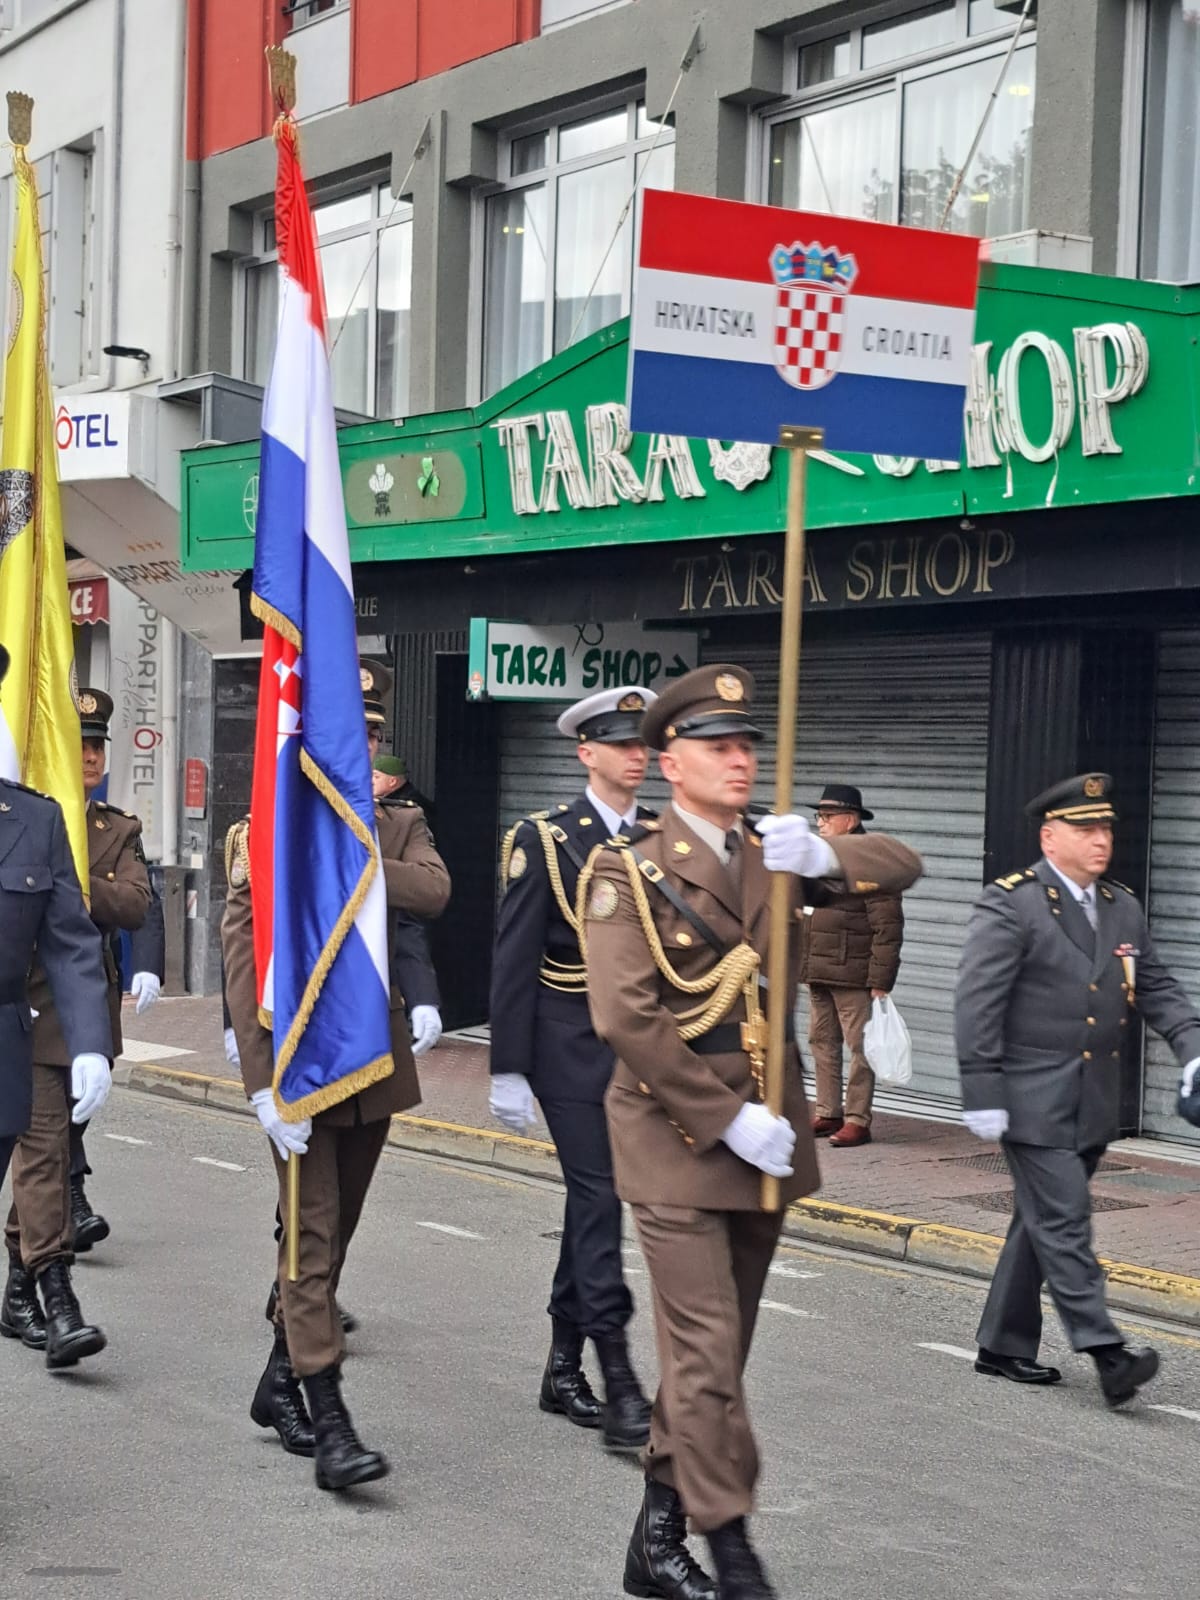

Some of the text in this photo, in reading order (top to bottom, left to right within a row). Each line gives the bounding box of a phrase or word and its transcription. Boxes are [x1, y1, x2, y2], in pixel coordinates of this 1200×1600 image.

[655, 299, 953, 361] HRVATSKA CROATIA
[490, 402, 706, 515] TARA
[673, 530, 1015, 611] TARA SHOP
[491, 643, 662, 689] TARA SHOP
